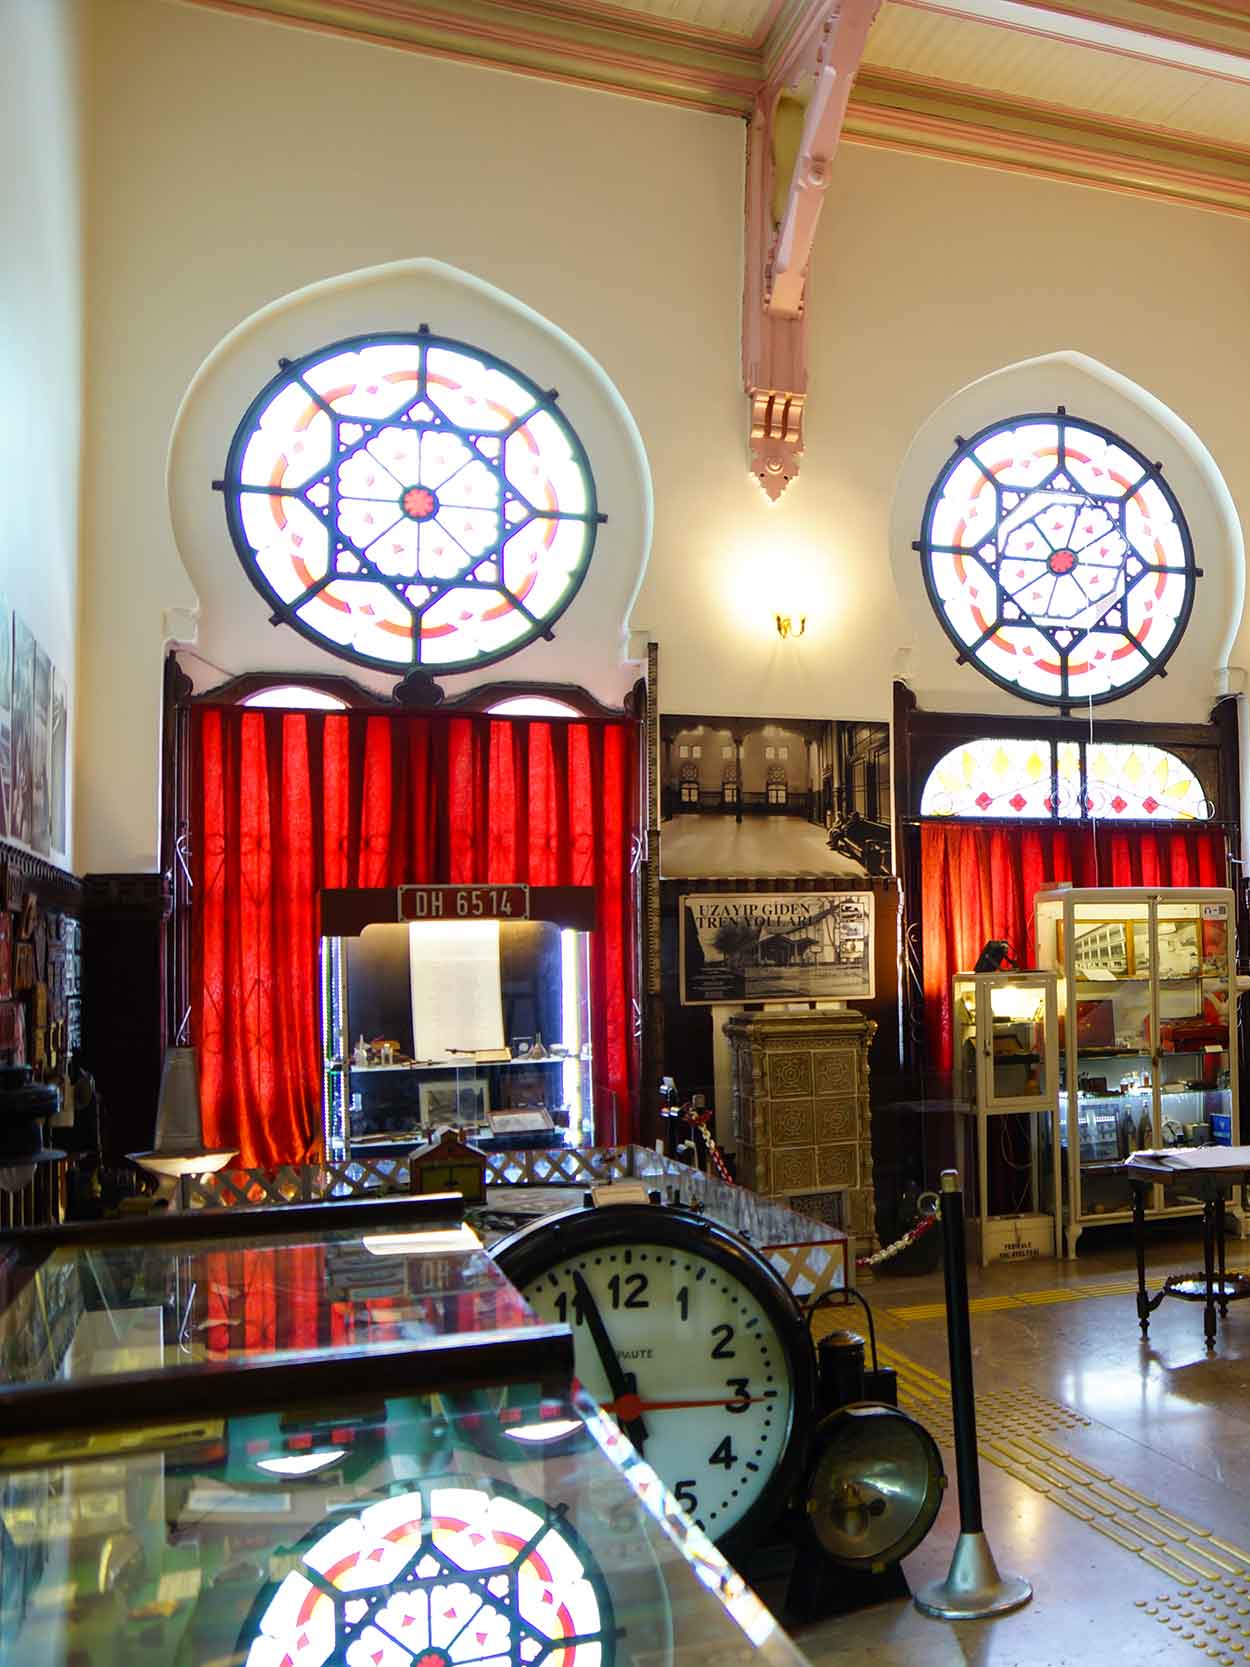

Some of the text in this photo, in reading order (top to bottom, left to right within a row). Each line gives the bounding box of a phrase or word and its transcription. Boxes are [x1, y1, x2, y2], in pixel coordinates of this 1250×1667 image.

[415, 890, 512, 917] DH 6514
[699, 903, 758, 917] UZAYIP
[696, 917, 740, 929] TREN
[554, 1291, 583, 1327] 11
[607, 1272, 649, 1310] 12
[676, 1285, 689, 1322] 1
[711, 1323, 736, 1360] 2
[725, 1377, 751, 1414] 3
[708, 1434, 738, 1471] 4
[674, 1479, 699, 1515] 5
